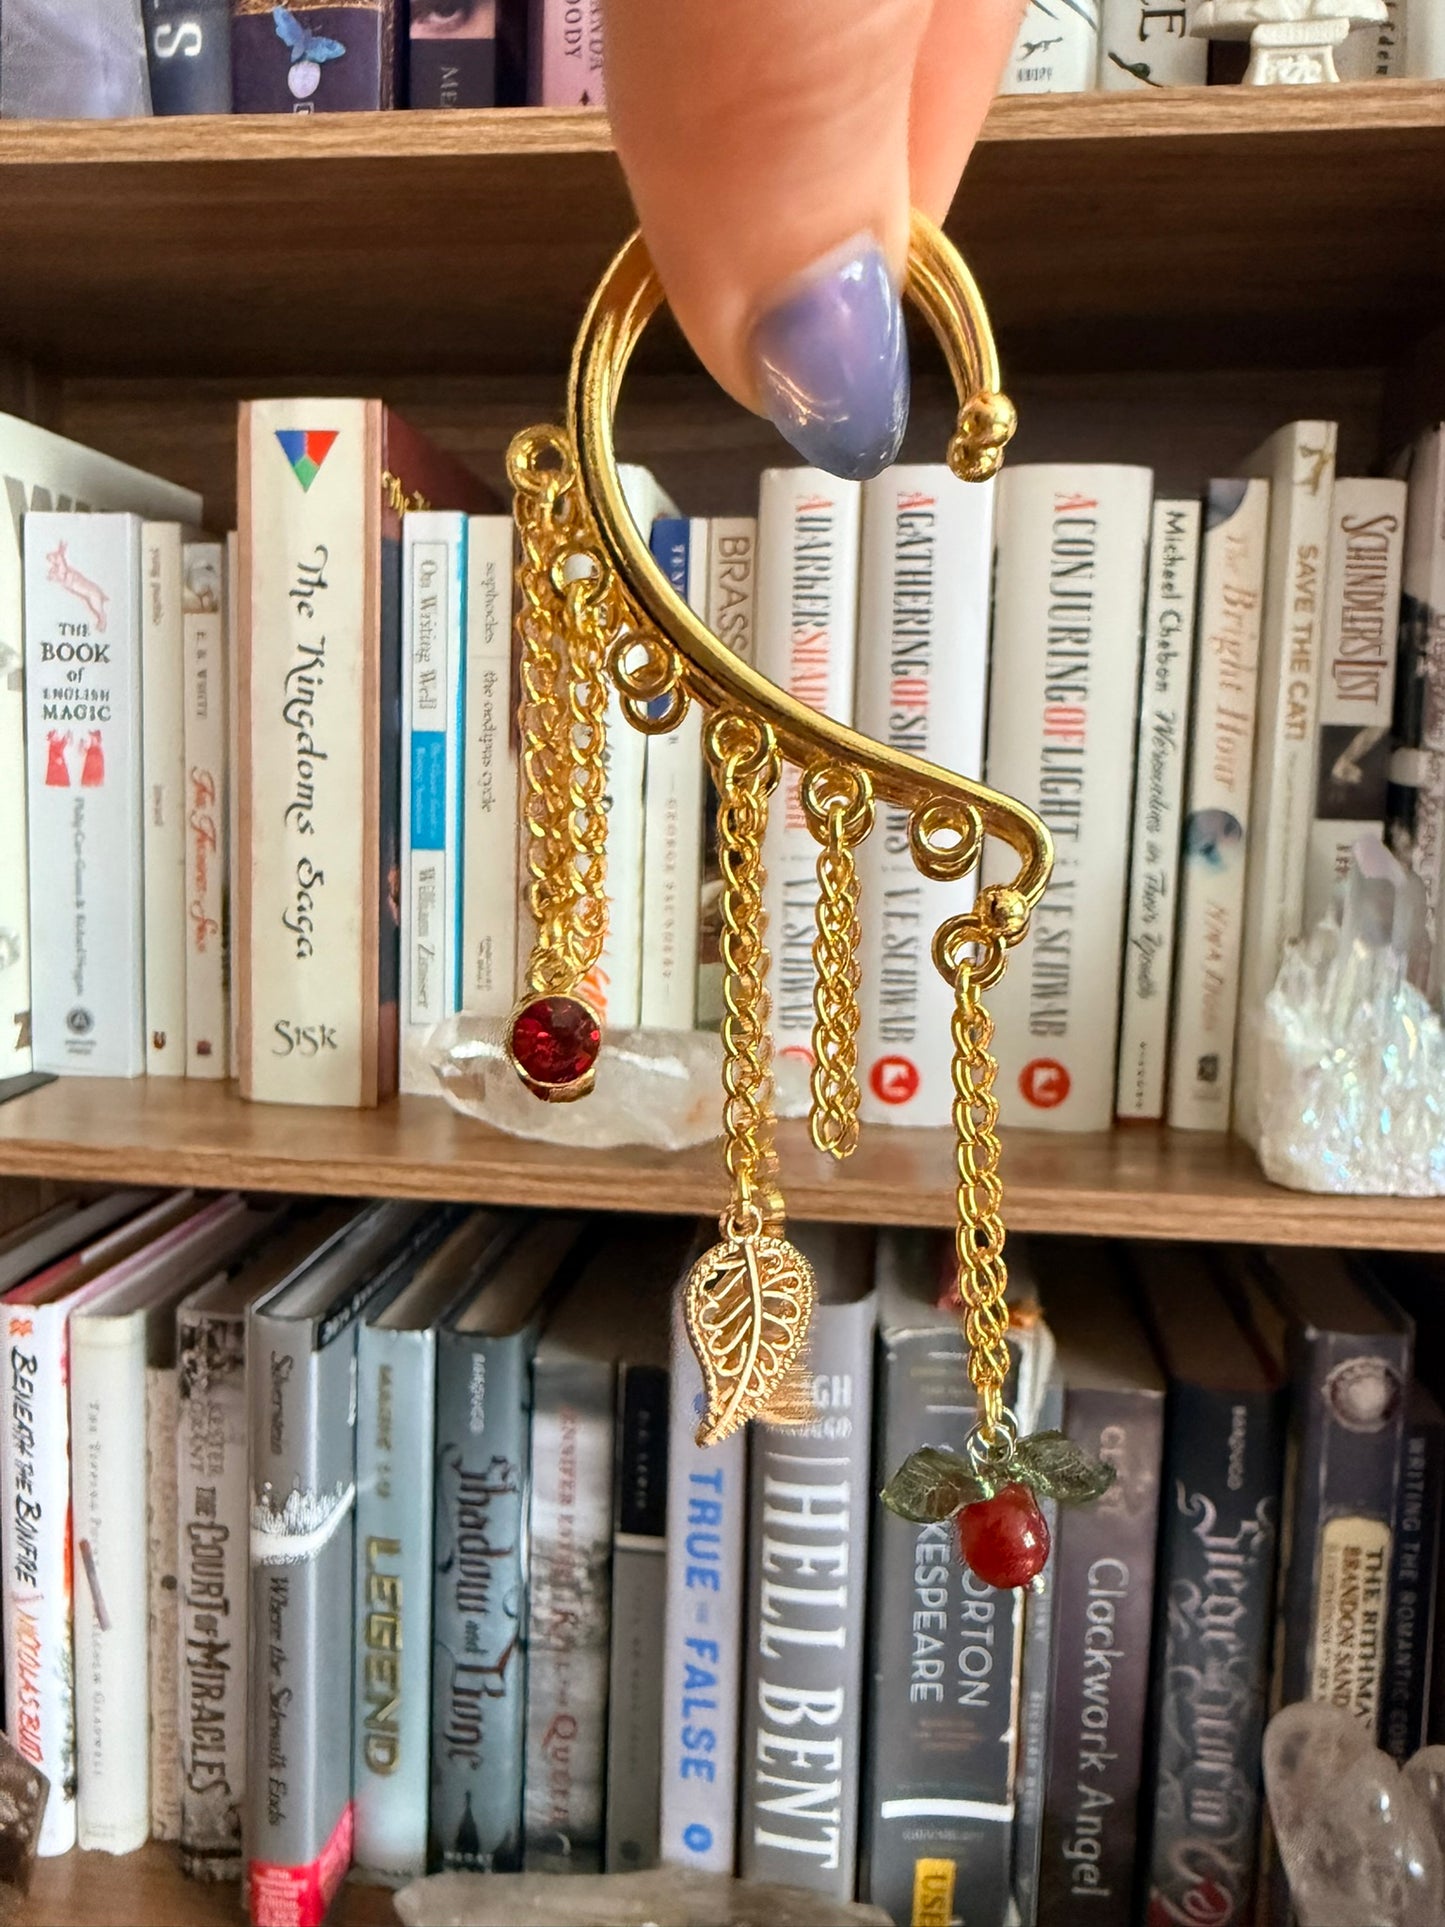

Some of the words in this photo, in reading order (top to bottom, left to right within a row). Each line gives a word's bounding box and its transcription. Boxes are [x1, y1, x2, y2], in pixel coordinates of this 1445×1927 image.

[154, 20, 203, 58] S
[1140, 8, 1187, 42] E
[797, 494, 834, 512] A
[897, 492, 938, 512] A
[1054, 492, 1099, 512] A
[289, 545, 329, 619] The
[420, 559, 439, 589] On
[792, 512, 832, 629] DARKER
[890, 511, 936, 676] GATHERING
[1161, 510, 1187, 600] Michael
[1294, 544, 1319, 611] SAVE
[58, 622, 90, 637] THE
[416, 596, 439, 663] Writing
[480, 561, 498, 645] sophocles
[1044, 516, 1097, 702] CONJURING
[1209, 584, 1258, 689] Bright
[40, 641, 111, 663] BOOK
[66, 667, 84, 682] of
[483, 670, 498, 698] the
[789, 629, 830, 713] SHAD
[1155, 610, 1181, 693] Chabon
[1289, 622, 1313, 672] THE
[1331, 657, 1389, 706] LIST
[41, 704, 112, 722] MAGIC
[42, 687, 111, 702] ENGLISH
[418, 669, 438, 710] Well
[888, 676, 928, 711] OF
[1042, 705, 1088, 747] OF
[283, 636, 329, 835] Kingdoms
[1212, 704, 1249, 792] Hour
[1040, 746, 1083, 842] LIGHT
[282, 857, 325, 960] Saga
[417, 866, 437, 937] William
[878, 933, 920, 1045] SCHWAB
[1029, 928, 1072, 1040] SCHWAB
[10, 1346, 38, 1456] BENEATH
[14, 1457, 35, 1494] THE
[194, 1486, 218, 1520] THE
[1402, 1437, 1426, 1532] WRITING
[14, 1495, 43, 1587] BONFIRE
[186, 1521, 231, 1617] COURT
[453, 1455, 519, 1614] Shadow
[685, 1467, 724, 1593] TRUE
[760, 1476, 851, 1660] HELL
[1399, 1542, 1421, 1582] THE
[268, 1576, 290, 1641] Where
[910, 1521, 951, 1704] KESPEARE
[1339, 1546, 1362, 1648] BRANDON
[1363, 1546, 1384, 1602] THE
[268, 1645, 289, 1677] the
[364, 1535, 403, 1778] LEGEND
[958, 1564, 995, 1707] ORTON
[1079, 1556, 1130, 1771] Clockwork
[187, 1638, 231, 1797] MIRACLES
[680, 1636, 720, 1783] FALSE
[1331, 1652, 1353, 1710] SAND
[267, 1684, 294, 1772] Sidewalk
[266, 1776, 288, 1827] Ends
[754, 1679, 845, 1870] BENT
[1062, 1783, 1115, 1896] Angel
